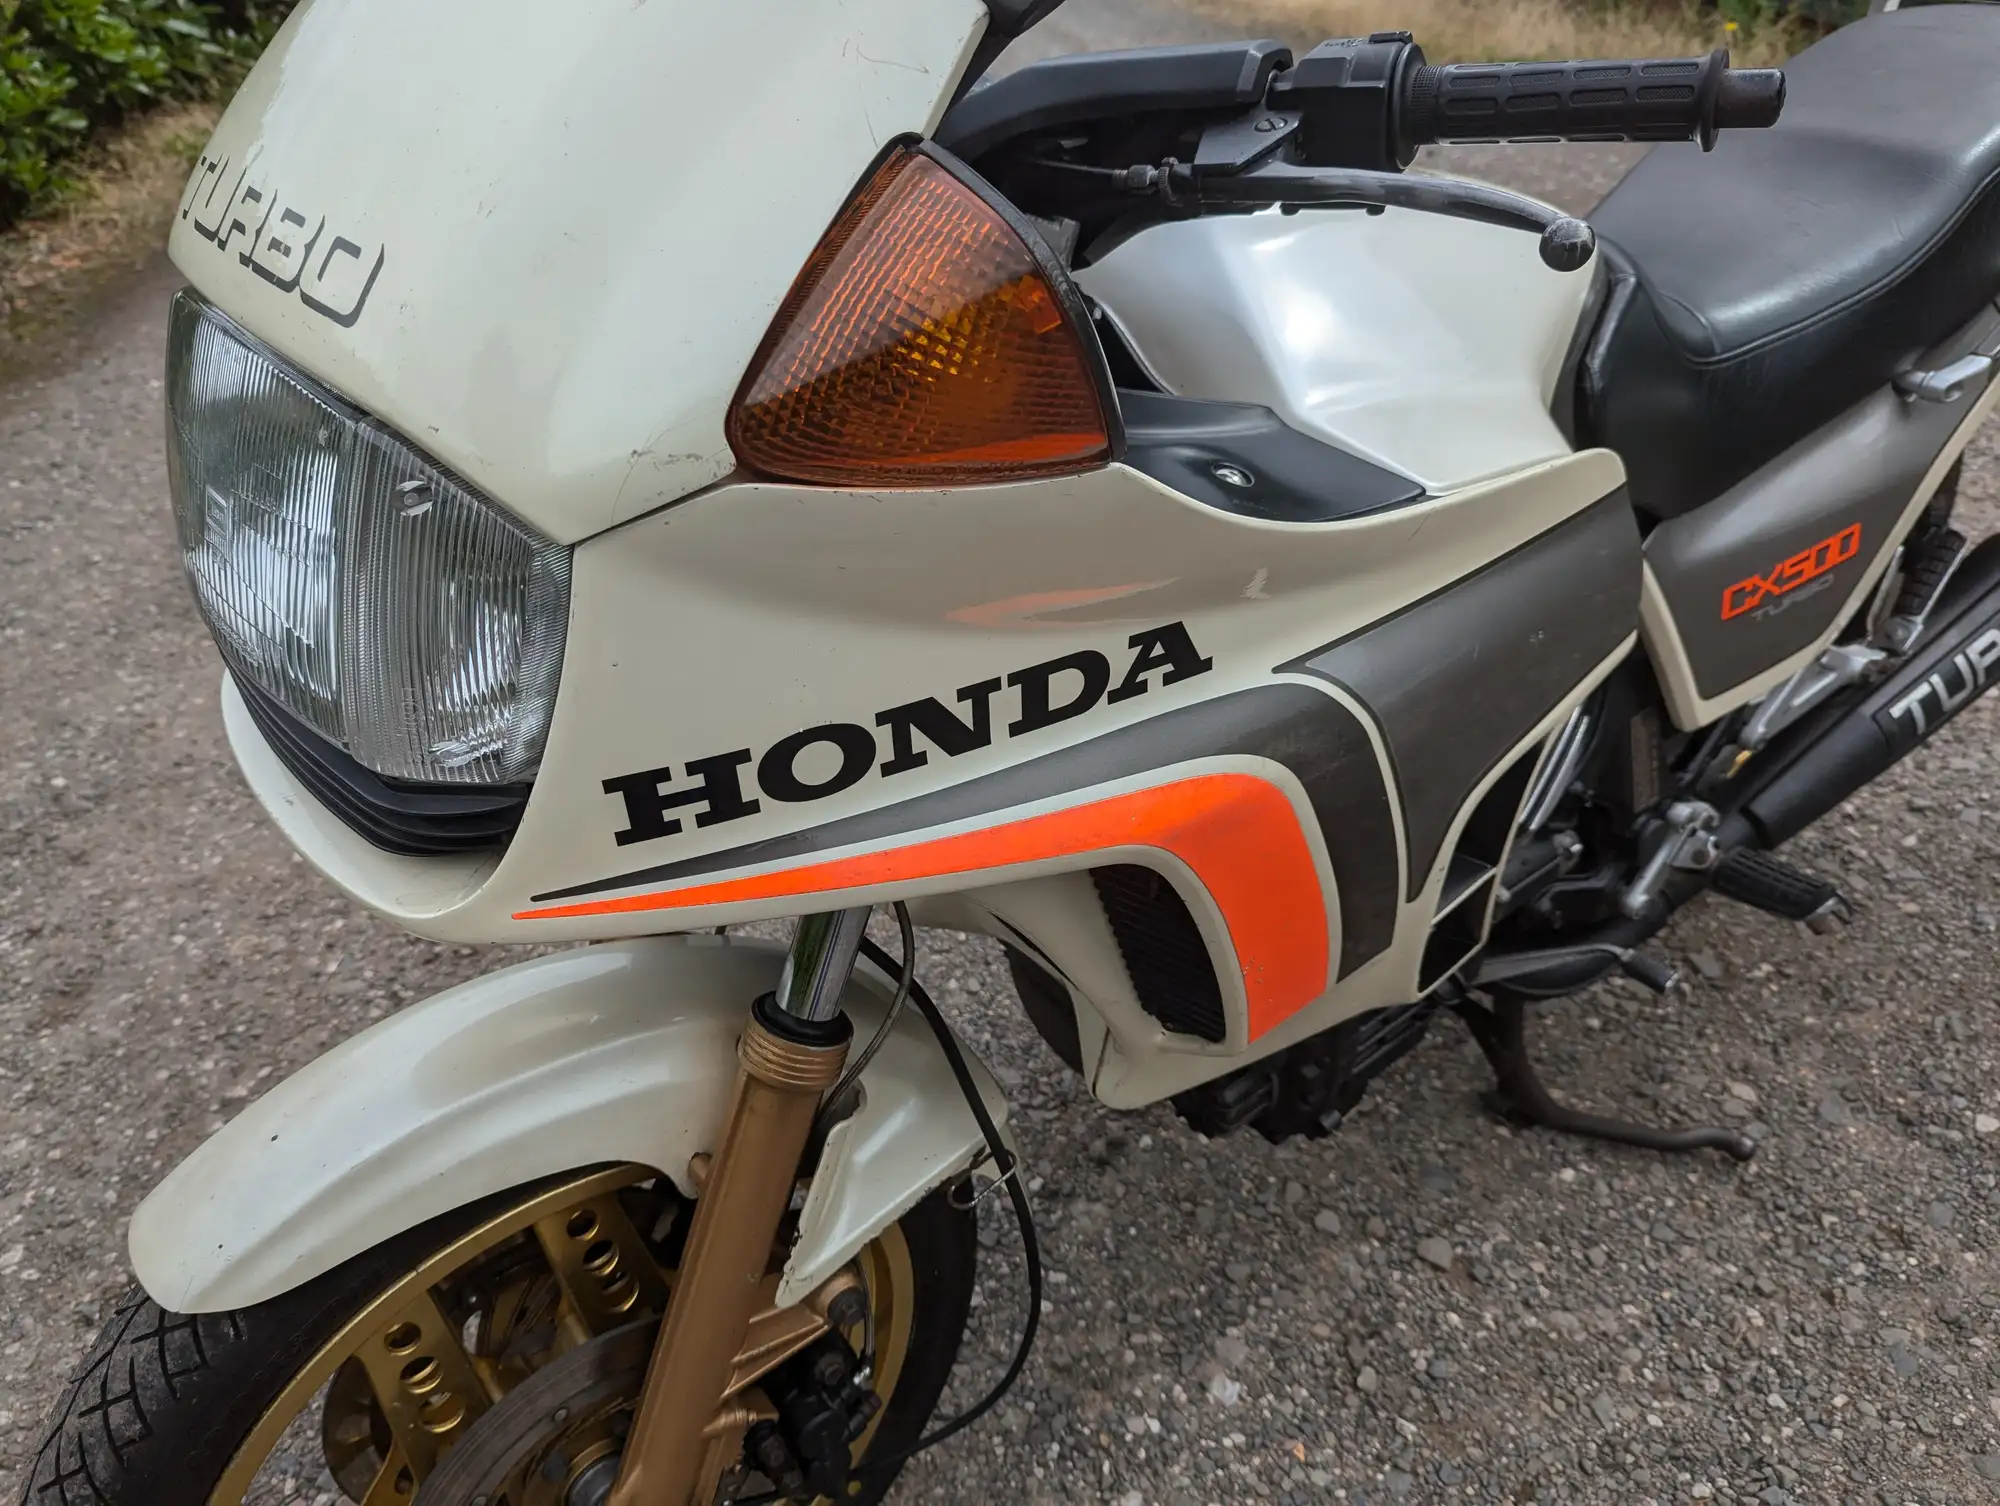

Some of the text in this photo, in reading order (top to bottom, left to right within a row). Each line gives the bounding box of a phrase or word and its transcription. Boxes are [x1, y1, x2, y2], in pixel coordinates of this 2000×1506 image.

[182, 152, 385, 328] TURBO
[1721, 522, 1862, 621] CX500
[602, 621, 1213, 847] HONDA
